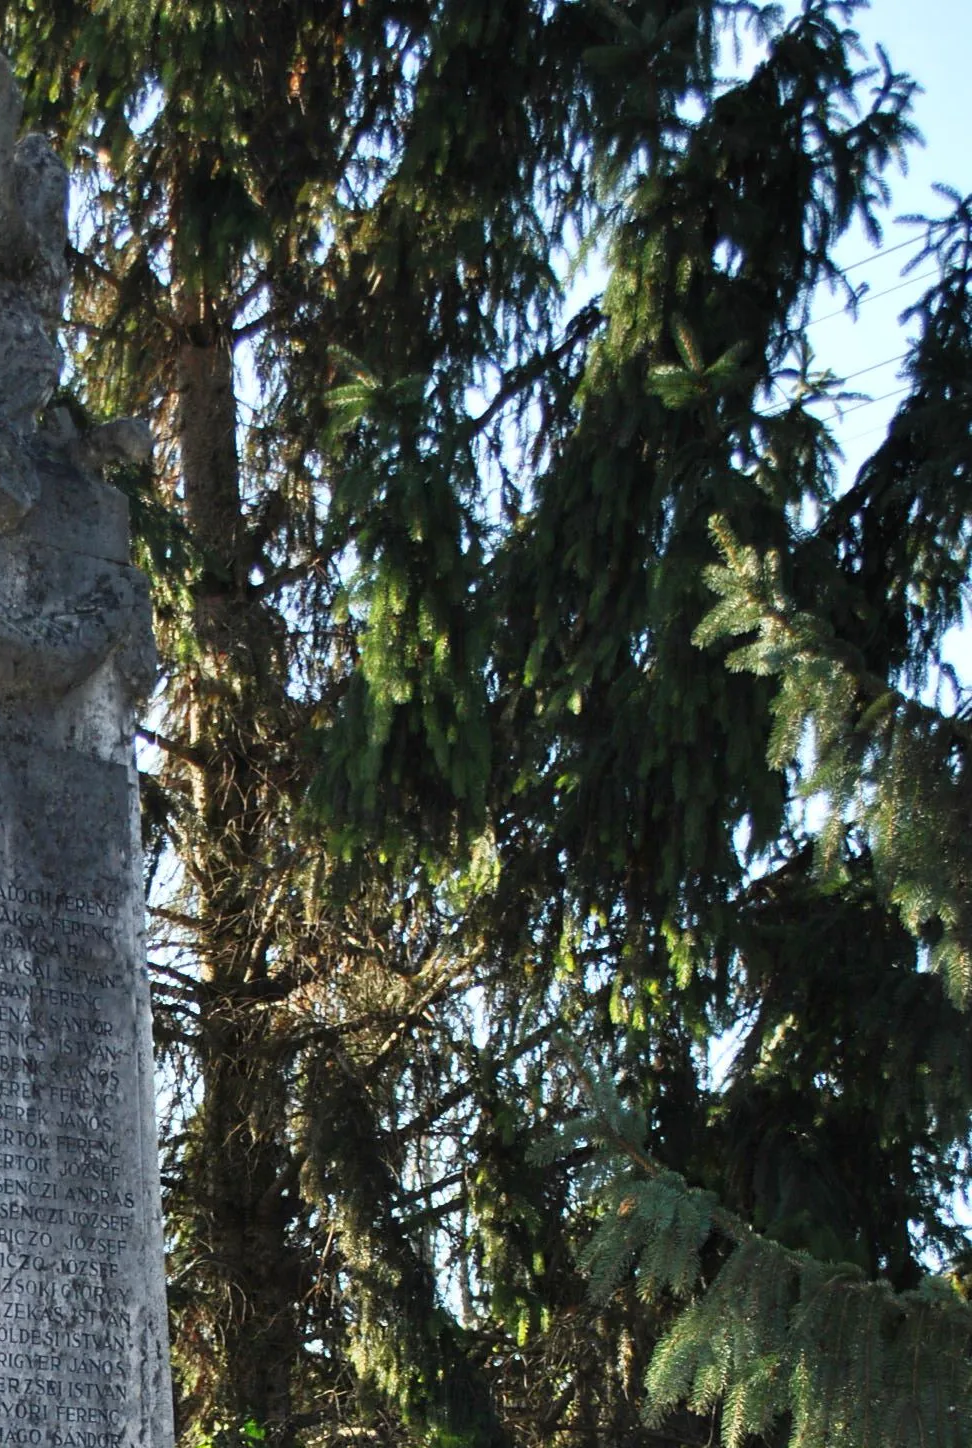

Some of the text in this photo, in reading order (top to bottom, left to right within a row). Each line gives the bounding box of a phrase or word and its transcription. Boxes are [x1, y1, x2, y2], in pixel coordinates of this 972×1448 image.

[52, 918, 114, 942] FERENC
[40, 988, 102, 1011] FERENC
[50, 1086, 115, 1108] FERENC
[57, 1135, 120, 1158] FERENC
[57, 1406, 120, 1426] FERENC
